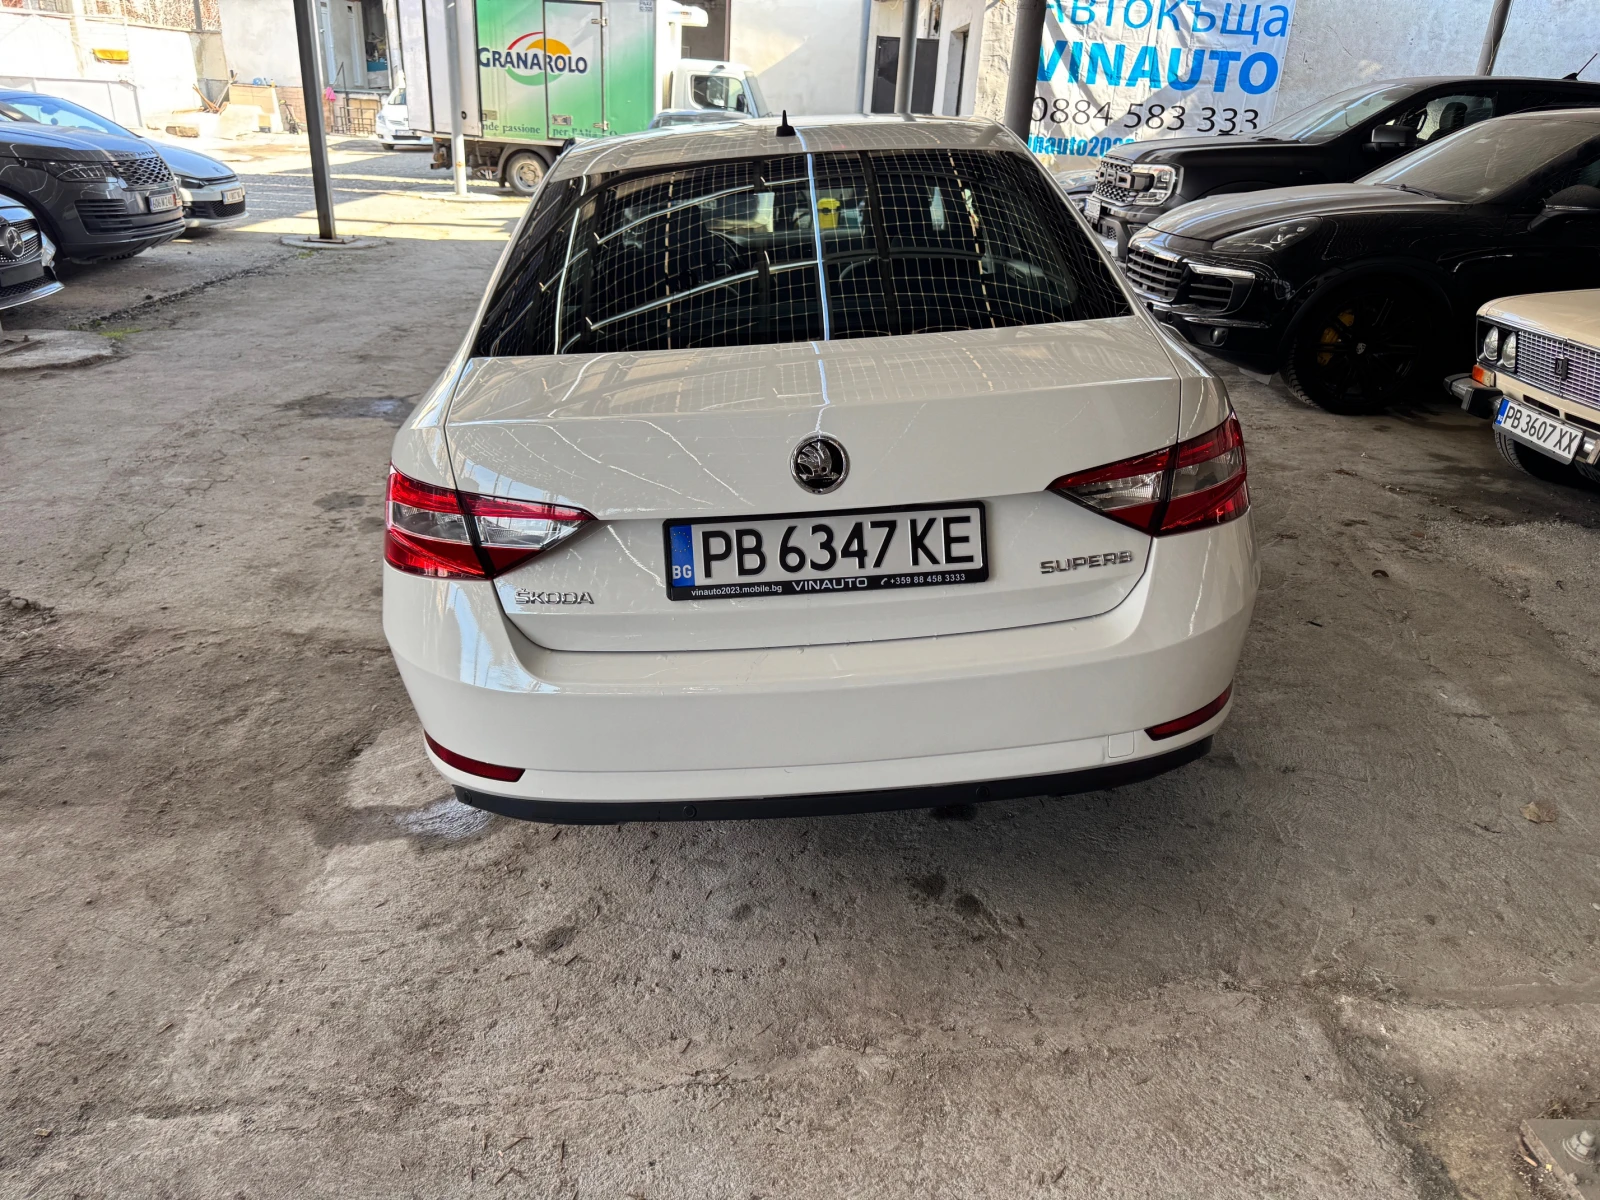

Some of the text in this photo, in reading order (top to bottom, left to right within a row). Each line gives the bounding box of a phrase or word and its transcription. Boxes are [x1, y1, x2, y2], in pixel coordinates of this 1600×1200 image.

[478, 47, 588, 74] GRANAROLO
[1037, 40, 1279, 95] VINAUTO
[1030, 97, 1259, 133] 0884 583 333
[502, 122, 541, 134] passione
[553, 128, 569, 137] per
[1503, 405, 1523, 430] PB
[1520, 413, 1557, 443] 3607
[1553, 427, 1578, 455] XX
[672, 515, 975, 580] BG PB 6347 KE
[1040, 550, 1133, 575] SUPERB
[515, 588, 595, 605] ŠKODA
[691, 573, 966, 596] vinauto2023.mobile.bg VINAUTO +359 88 458 3333
